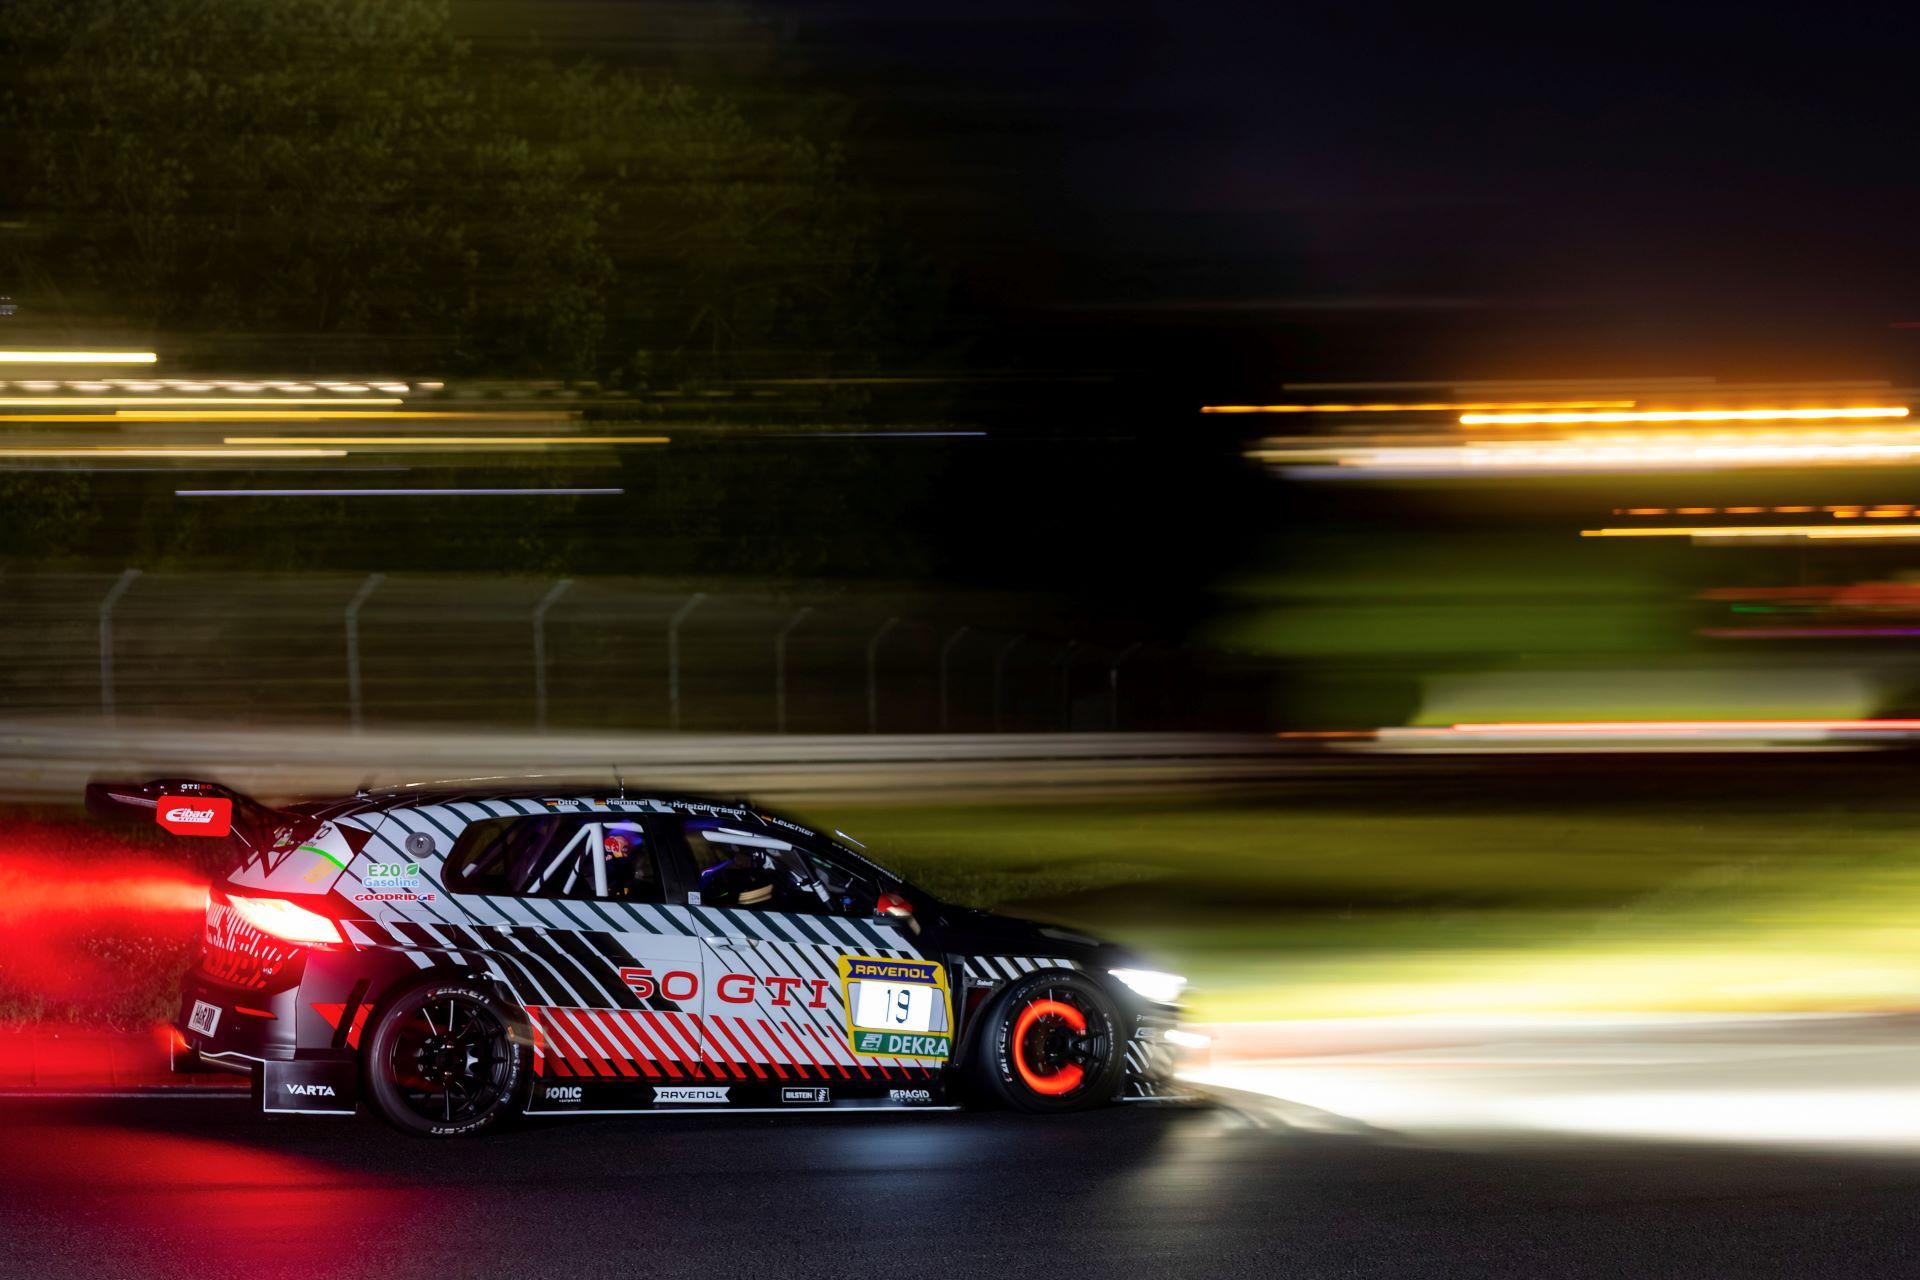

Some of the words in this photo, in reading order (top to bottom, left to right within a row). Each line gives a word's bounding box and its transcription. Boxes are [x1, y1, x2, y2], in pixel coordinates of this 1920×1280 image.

[606, 798, 649, 806] Hammel
[165, 807, 215, 824] Eibach
[772, 816, 816, 838] Leuchter
[367, 863, 401, 876] E20
[363, 876, 419, 887] Gasoline
[355, 893, 436, 901] GOODRIDGE
[855, 963, 930, 979] RAVENOL
[620, 967, 698, 1001] 50
[717, 973, 830, 1009] GTI
[885, 989, 911, 1024] 19
[888, 1034, 949, 1057] DEKRA
[286, 1084, 337, 1097] VARTA
[660, 1090, 723, 1099] RAVENOL
[785, 1091, 813, 1099] BILSTEIN
[899, 1088, 930, 1099] PAGID
